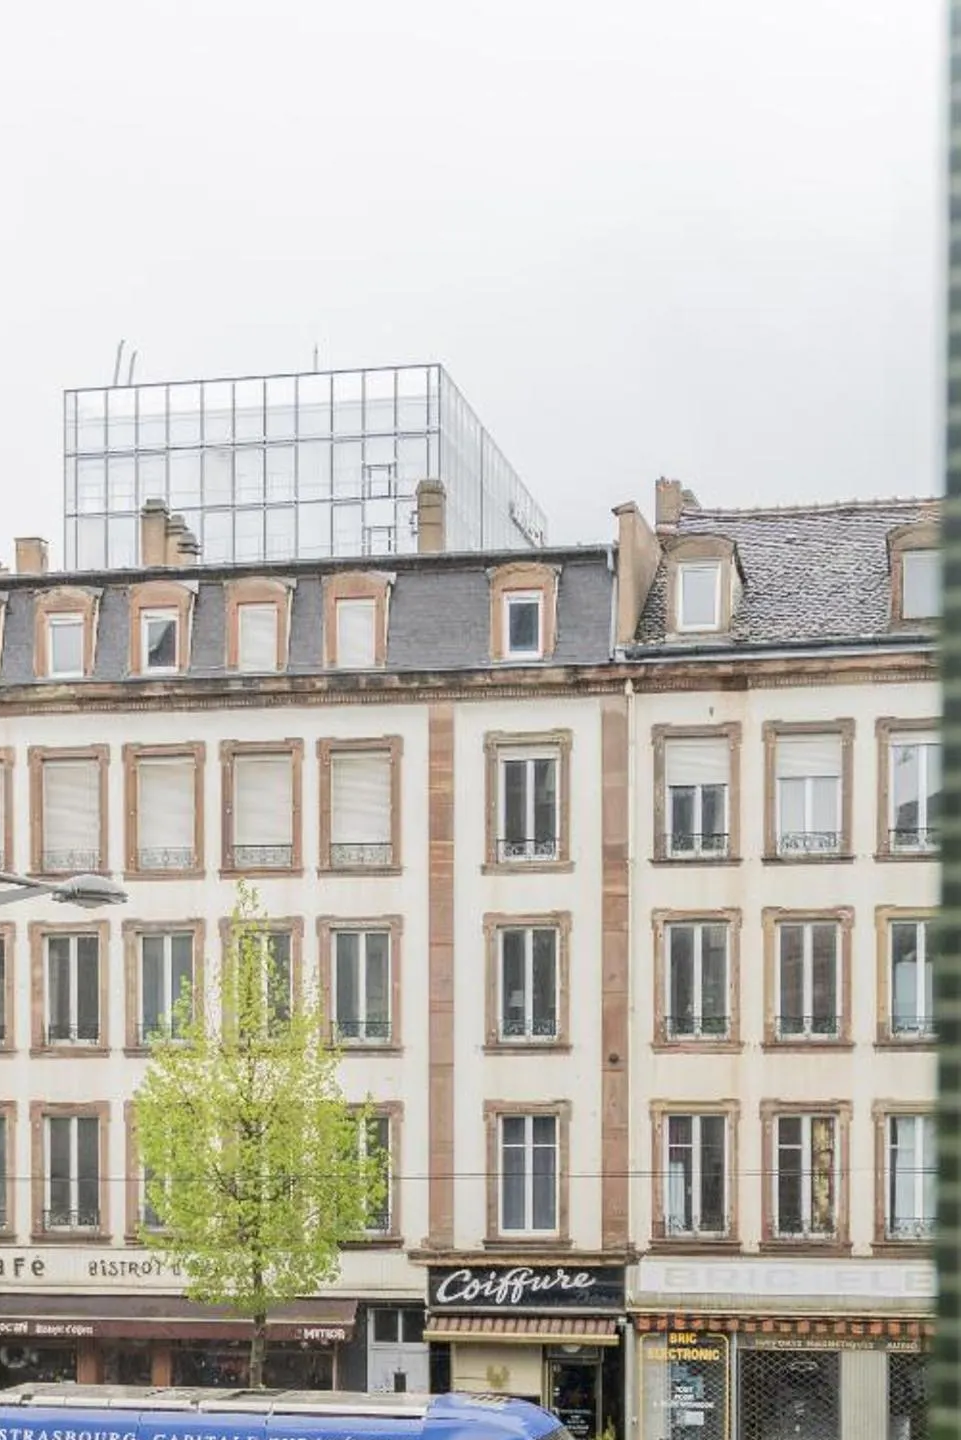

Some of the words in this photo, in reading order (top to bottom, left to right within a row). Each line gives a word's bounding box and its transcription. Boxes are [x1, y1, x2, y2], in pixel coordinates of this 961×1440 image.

[436, 1267, 597, 1304] Coiffure
[668, 1332, 697, 1345] BRIC
[647, 1347, 721, 1361] ELECTRONIC
